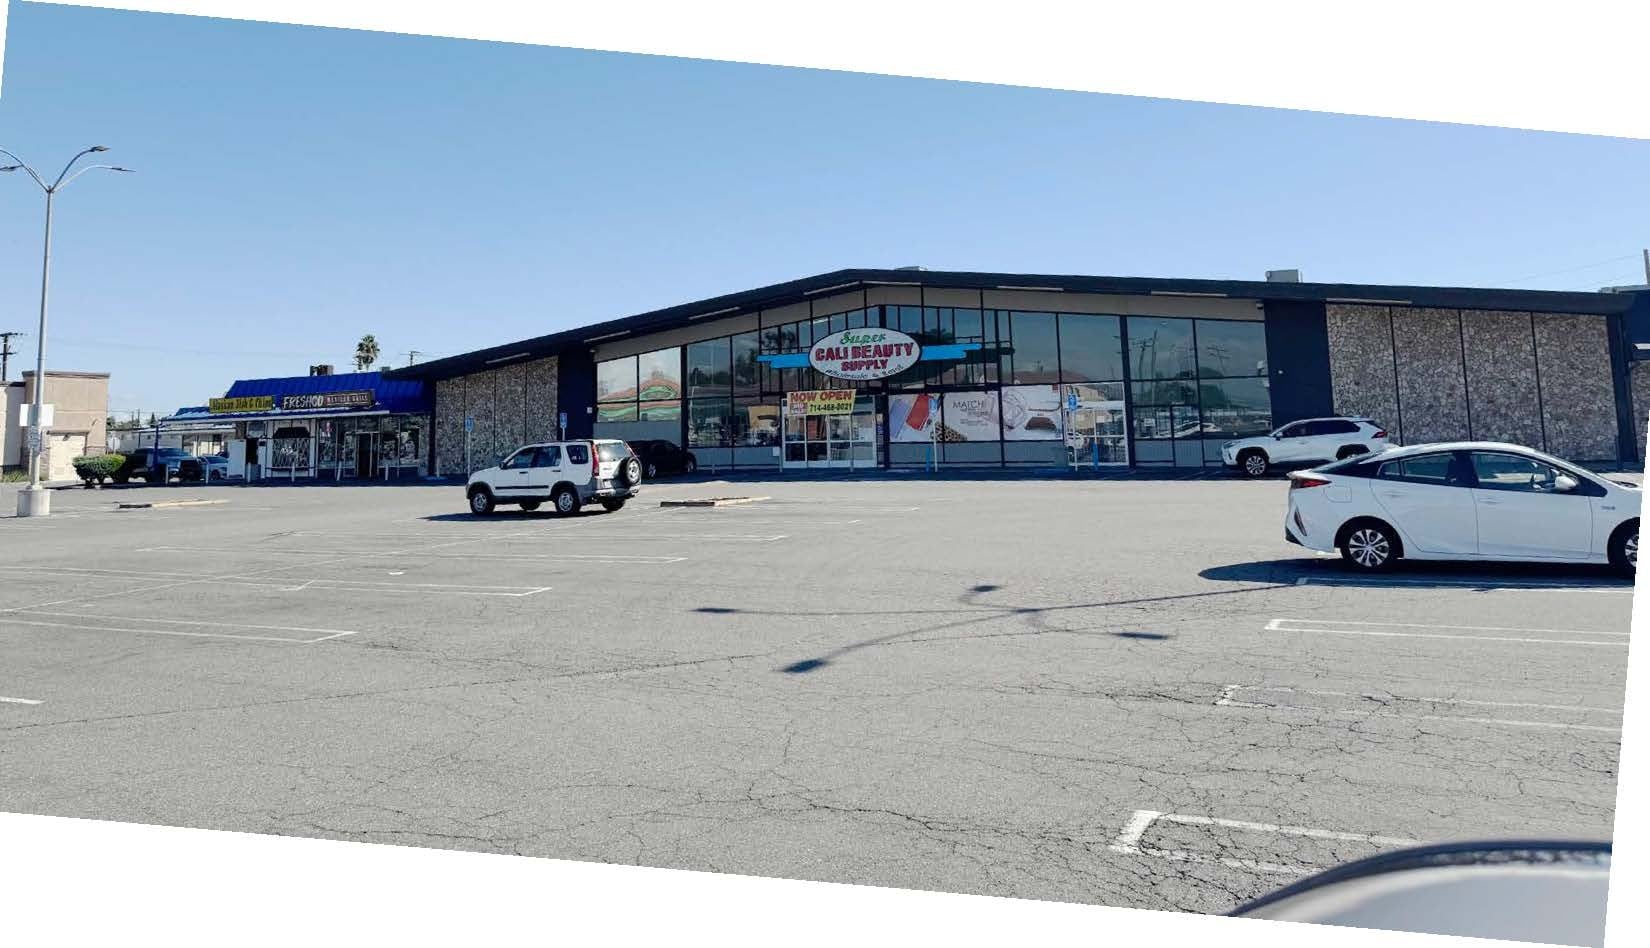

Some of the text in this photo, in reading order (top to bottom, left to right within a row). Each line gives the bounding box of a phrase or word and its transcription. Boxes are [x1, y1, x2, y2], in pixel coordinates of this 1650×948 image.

[840, 331, 886, 345] Super
[815, 342, 914, 361] CALI BEAUTY
[841, 359, 889, 371] SUPPLY
[791, 390, 852, 402] NOW OPEN
